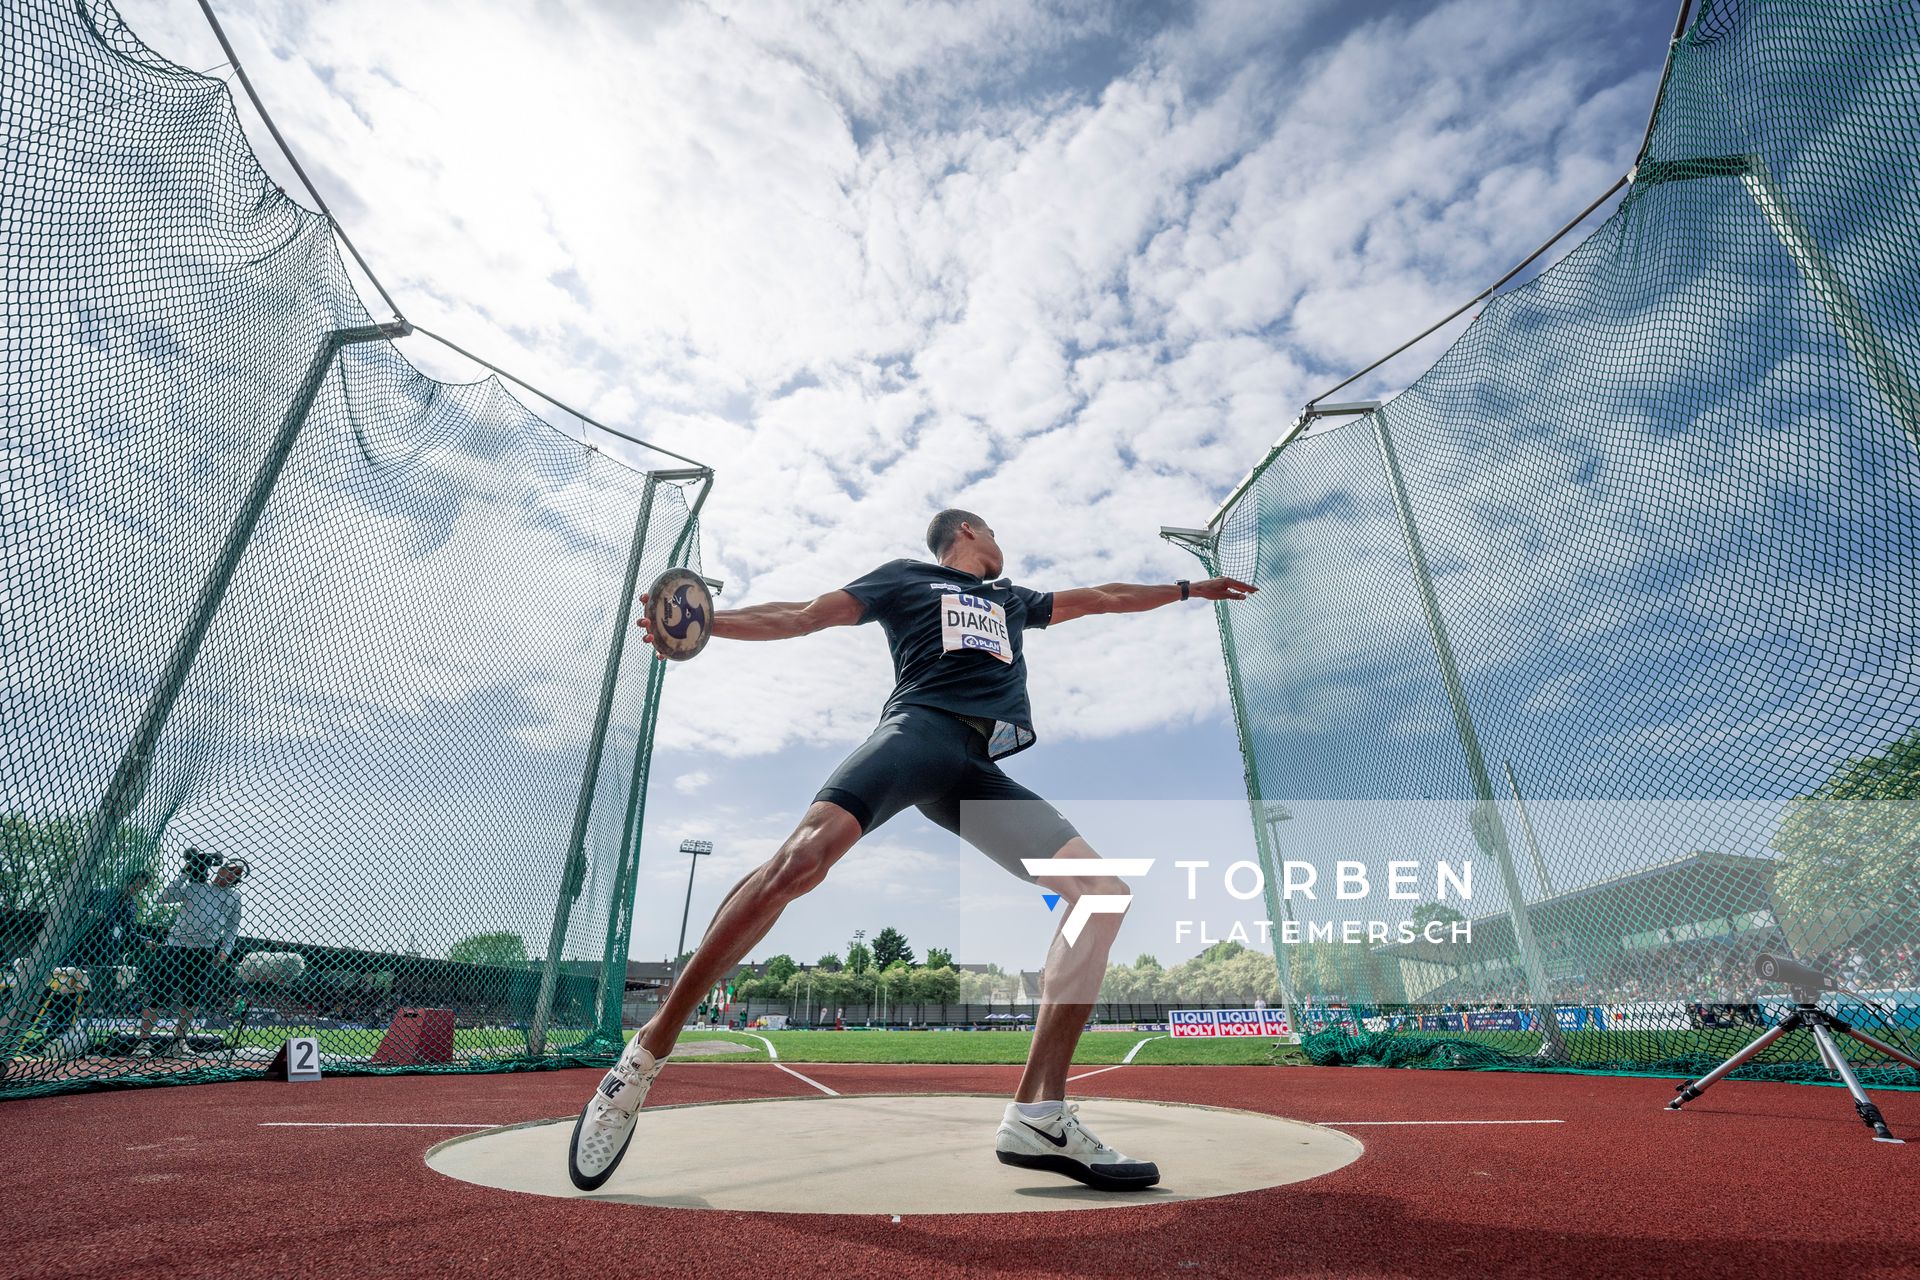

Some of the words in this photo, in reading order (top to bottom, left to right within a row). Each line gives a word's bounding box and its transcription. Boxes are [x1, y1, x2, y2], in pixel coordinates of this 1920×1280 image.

[1174, 1012, 1212, 1024] LIQUI
[1218, 1011, 1257, 1023] LIQUI
[1175, 1024, 1215, 1036] MOLY
[1221, 1023, 1261, 1035] MOLY
[1267, 1023, 1289, 1036] MO
[296, 1041, 314, 1070] 2
